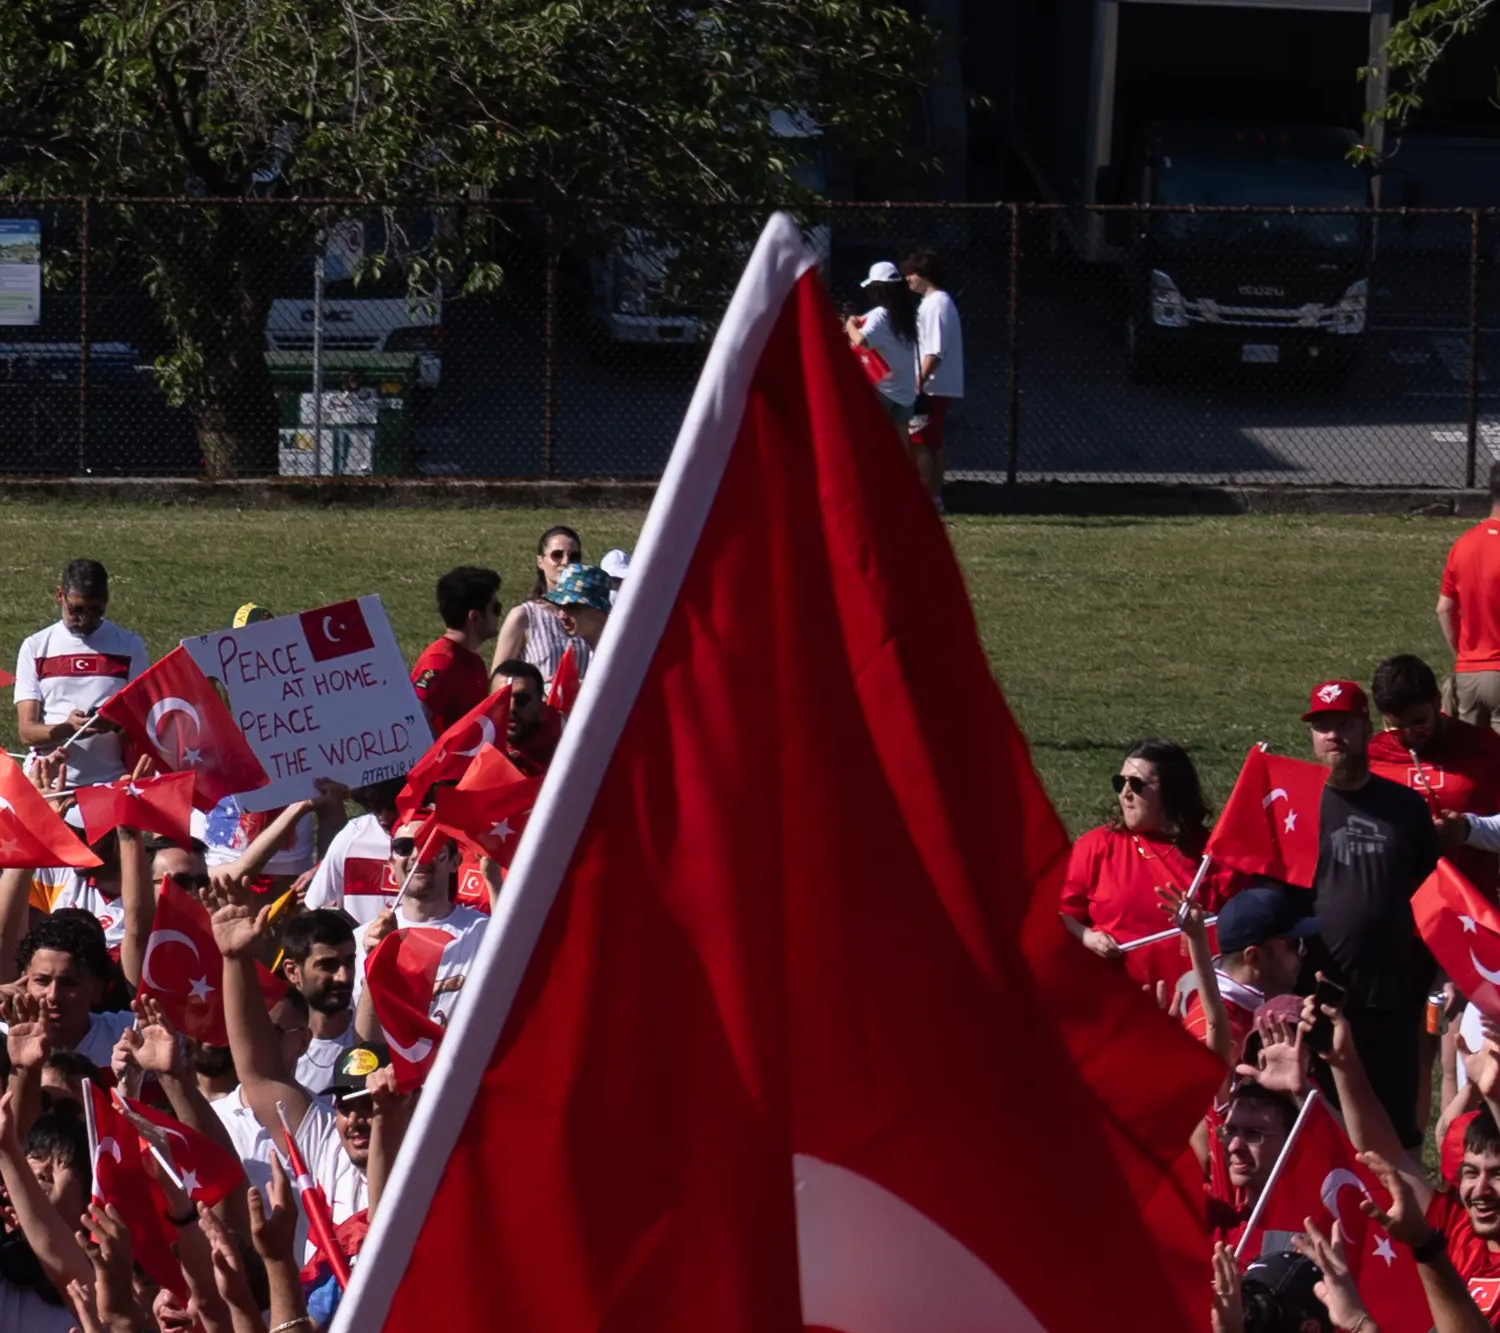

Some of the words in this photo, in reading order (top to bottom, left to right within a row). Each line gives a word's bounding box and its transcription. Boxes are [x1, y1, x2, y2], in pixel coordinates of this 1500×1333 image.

[282, 672, 308, 701] AT
[242, 705, 320, 740] PEACE
[271, 736, 310, 788] THE
